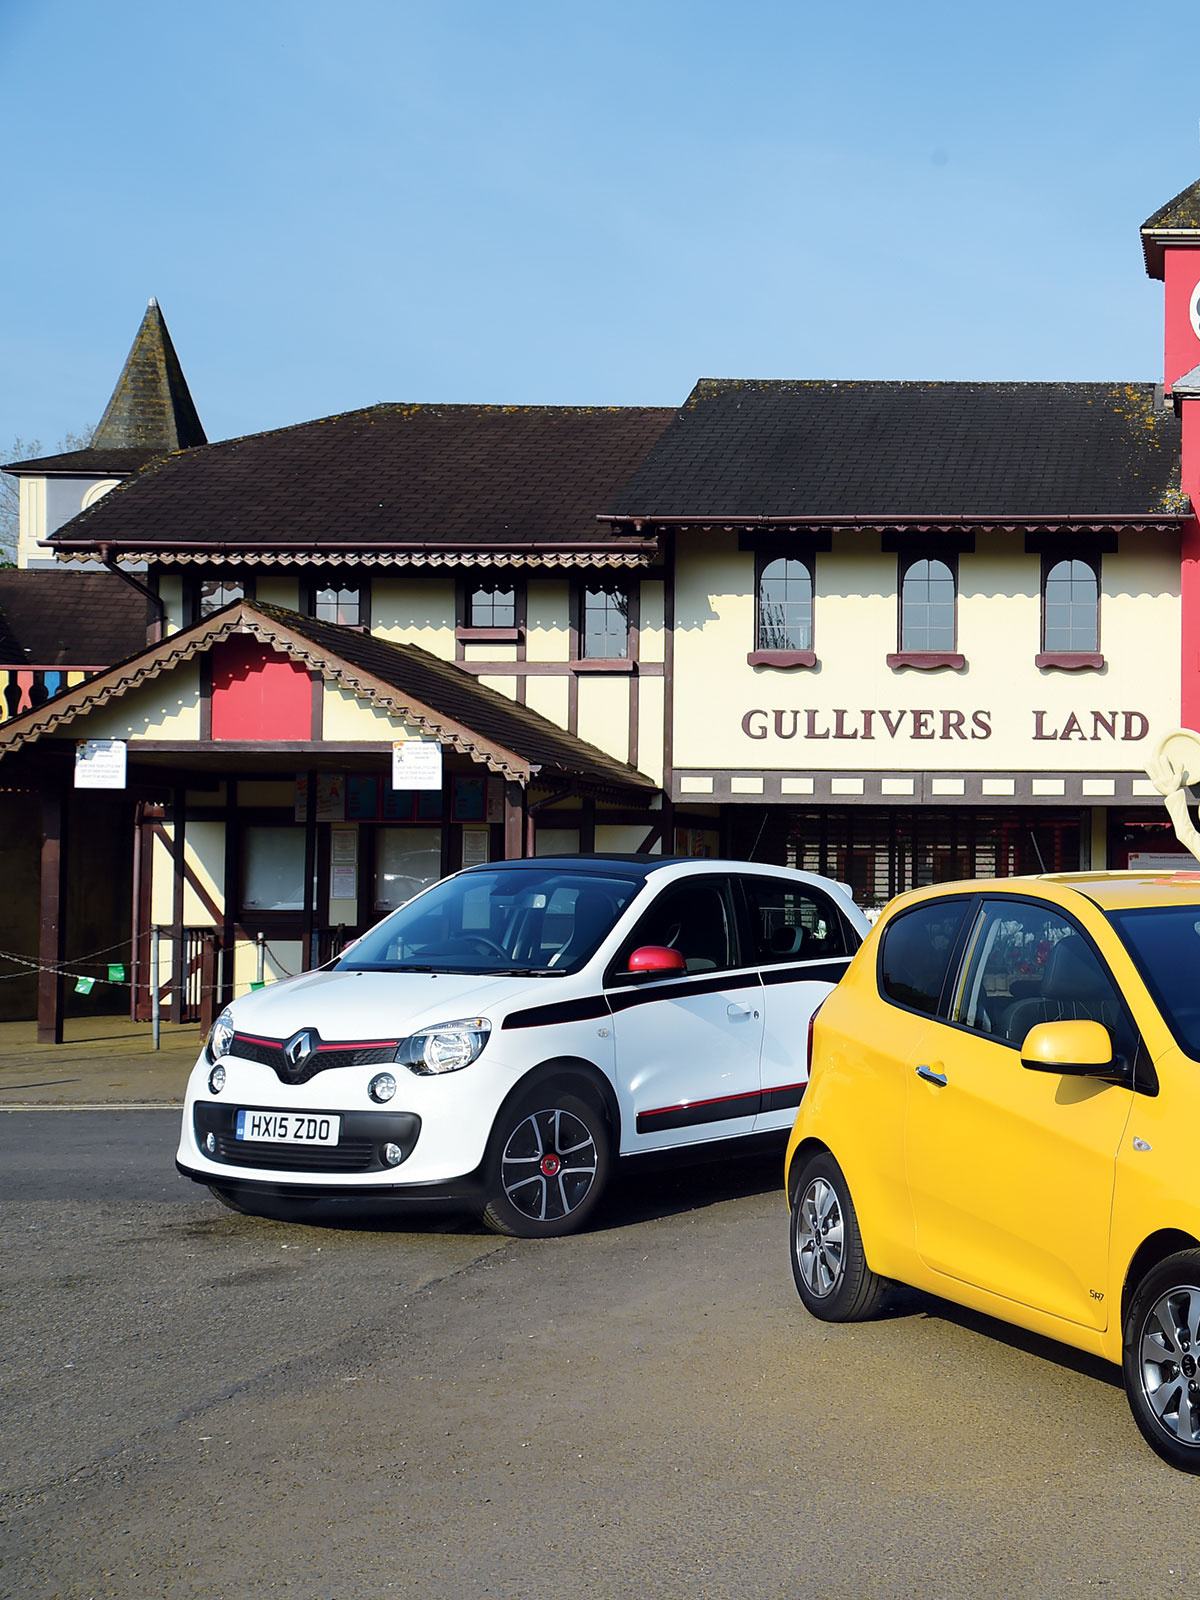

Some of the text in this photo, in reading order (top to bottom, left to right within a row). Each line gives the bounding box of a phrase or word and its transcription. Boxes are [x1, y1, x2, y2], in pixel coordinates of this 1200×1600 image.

[741, 709, 1149, 740] GULLIVERS LAND
[250, 1115, 330, 1140] HX15 ZDO
